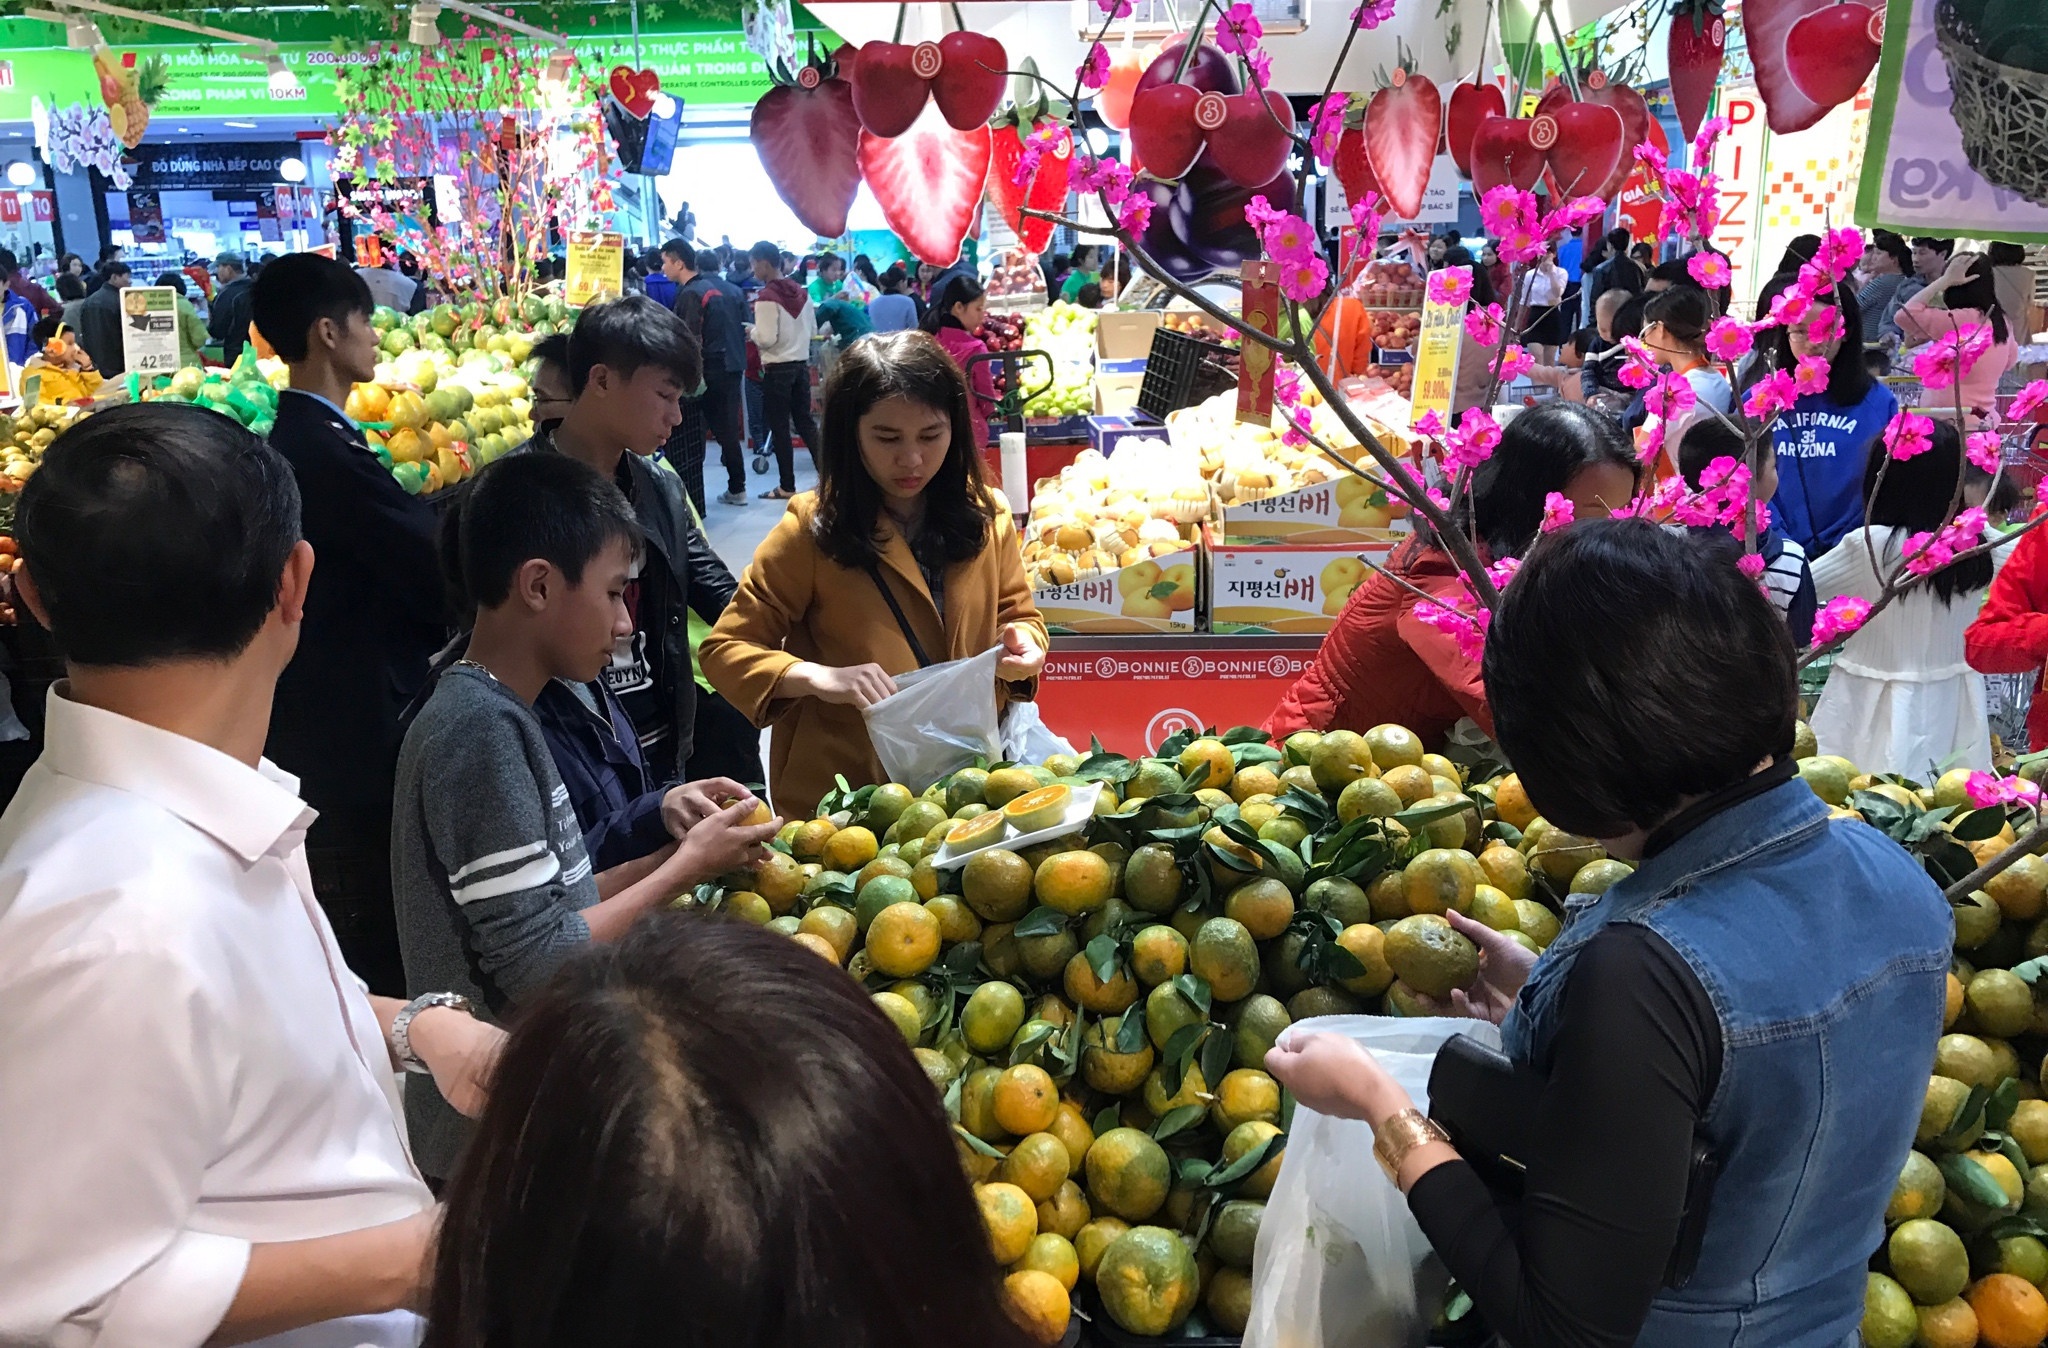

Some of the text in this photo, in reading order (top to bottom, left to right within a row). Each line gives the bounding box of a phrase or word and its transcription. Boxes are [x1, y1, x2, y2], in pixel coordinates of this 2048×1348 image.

[699, 62, 748, 75] TRONG
[269, 88, 306, 99] 10KM
[249, 159, 272, 171] CAO
[34, 197, 51, 215] 10
[140, 355, 158, 369] 42
[1772, 411, 1858, 435] ALIFORNIA
[1801, 429, 1816, 444] 35
[1777, 440, 1837, 458] ARIZONA
[1169, 621, 1186, 629] 15kg
[1040, 661, 1093, 674] ONNIE
[1118, 661, 1180, 673] BONNIE
[1204, 660, 1267, 673] BONNIE
